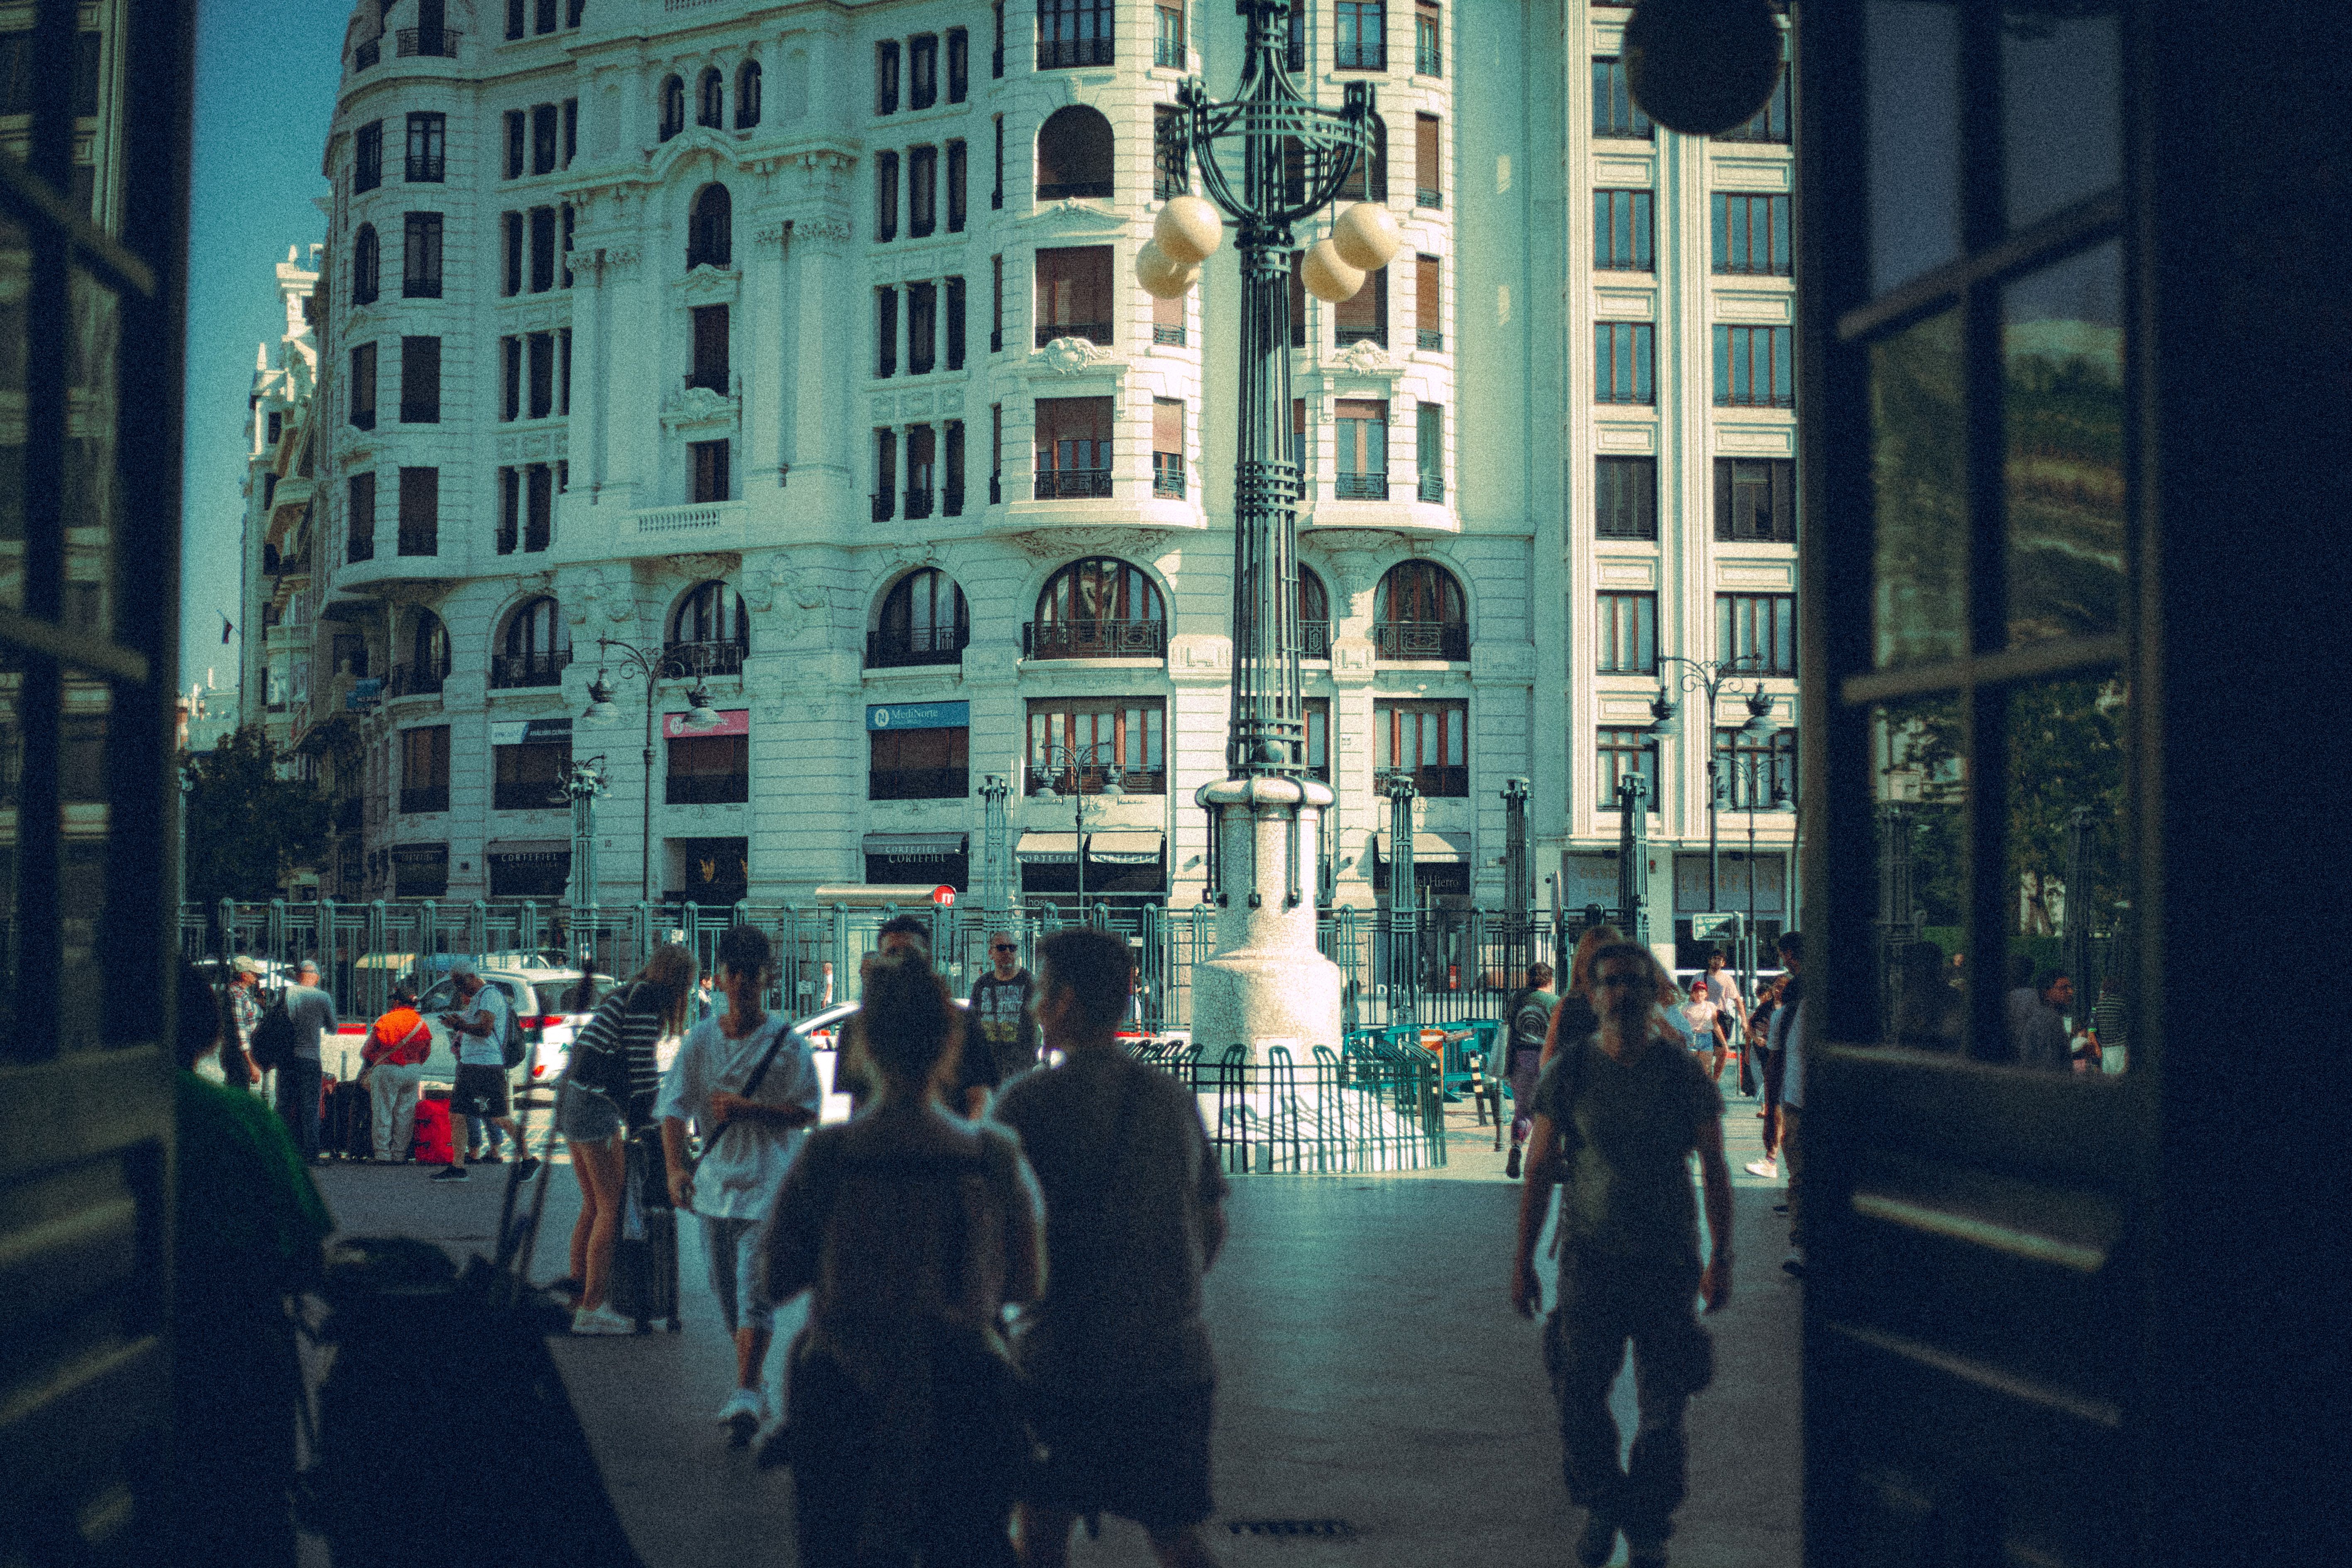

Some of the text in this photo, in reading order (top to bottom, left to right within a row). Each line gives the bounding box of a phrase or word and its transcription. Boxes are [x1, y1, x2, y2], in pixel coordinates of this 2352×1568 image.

[892, 708, 938, 719] MediNorte
[501, 853, 557, 862] CORTEFIEL
[889, 854, 945, 863] CORTEFIEL
[1429, 876, 1459, 887] Hierro
